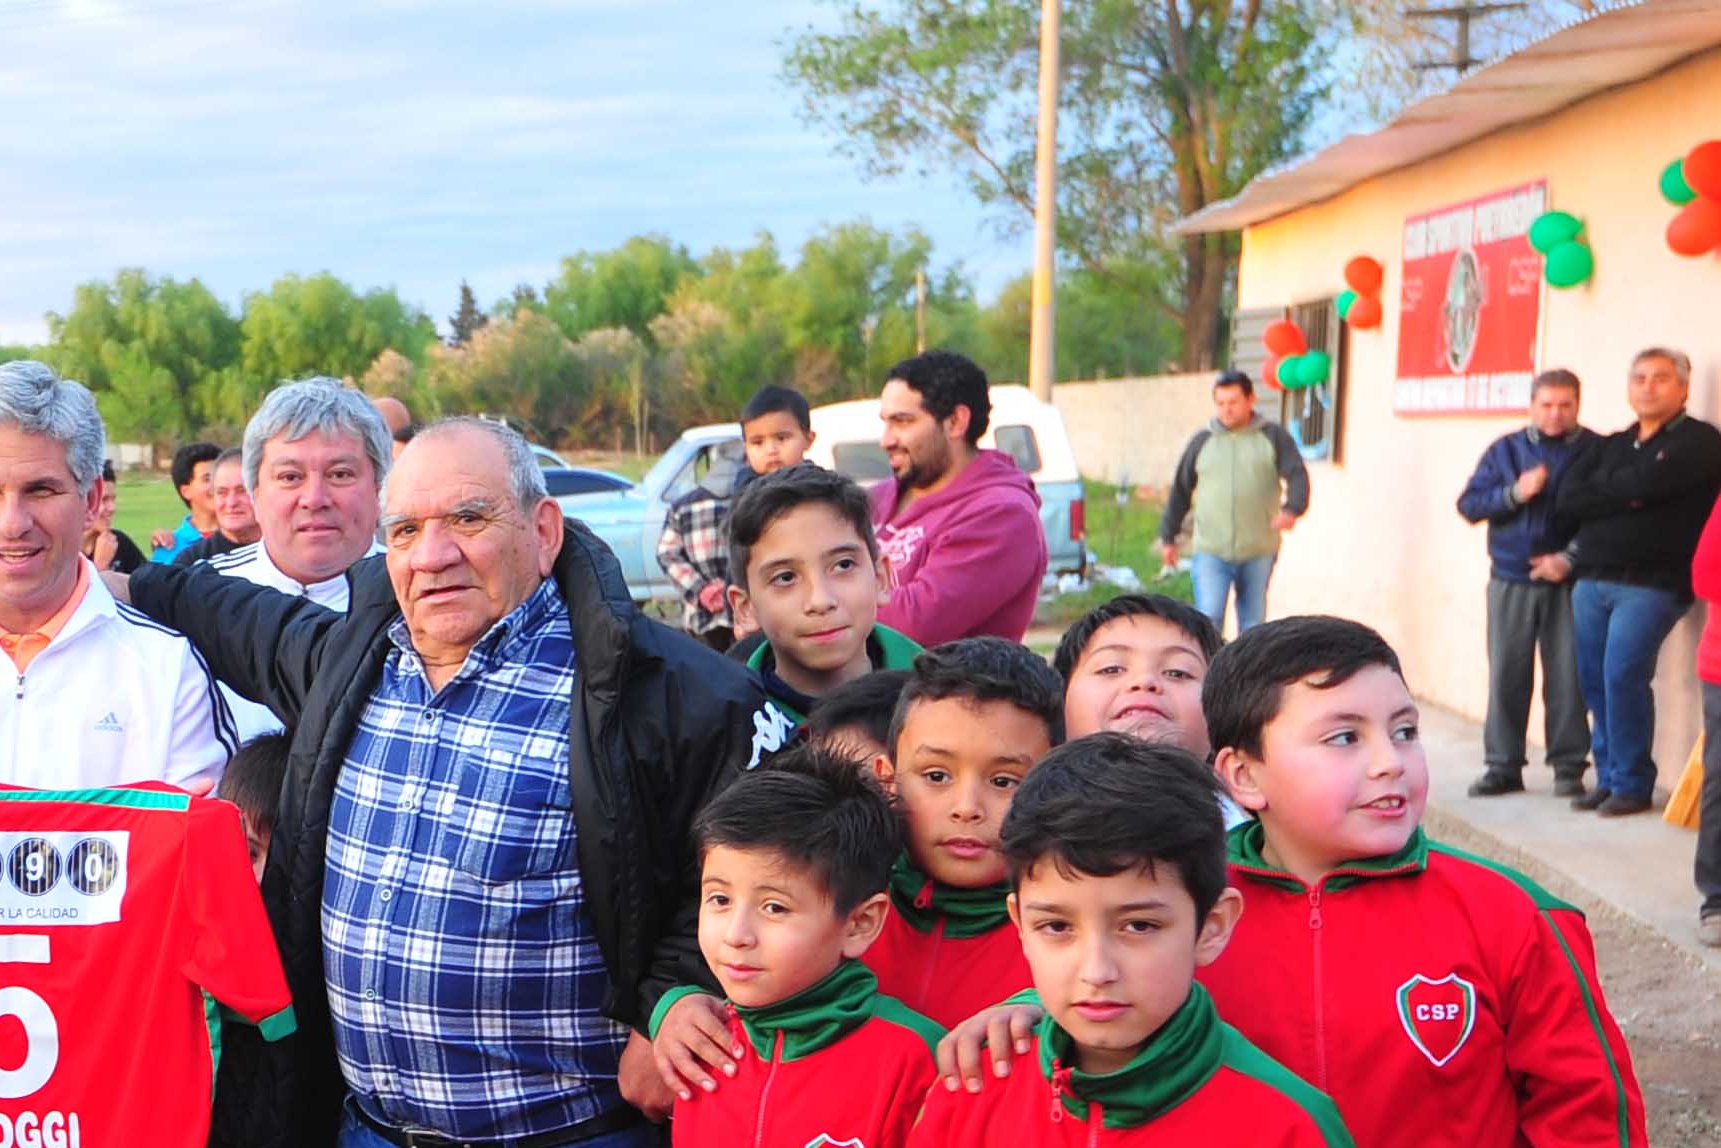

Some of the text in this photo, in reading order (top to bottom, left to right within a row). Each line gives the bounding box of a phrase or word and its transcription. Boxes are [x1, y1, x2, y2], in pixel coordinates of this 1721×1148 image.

[8, 908, 24, 919] LA
[26, 907, 79, 919] CALIDAD
[1416, 1003, 1460, 1021] CSP
